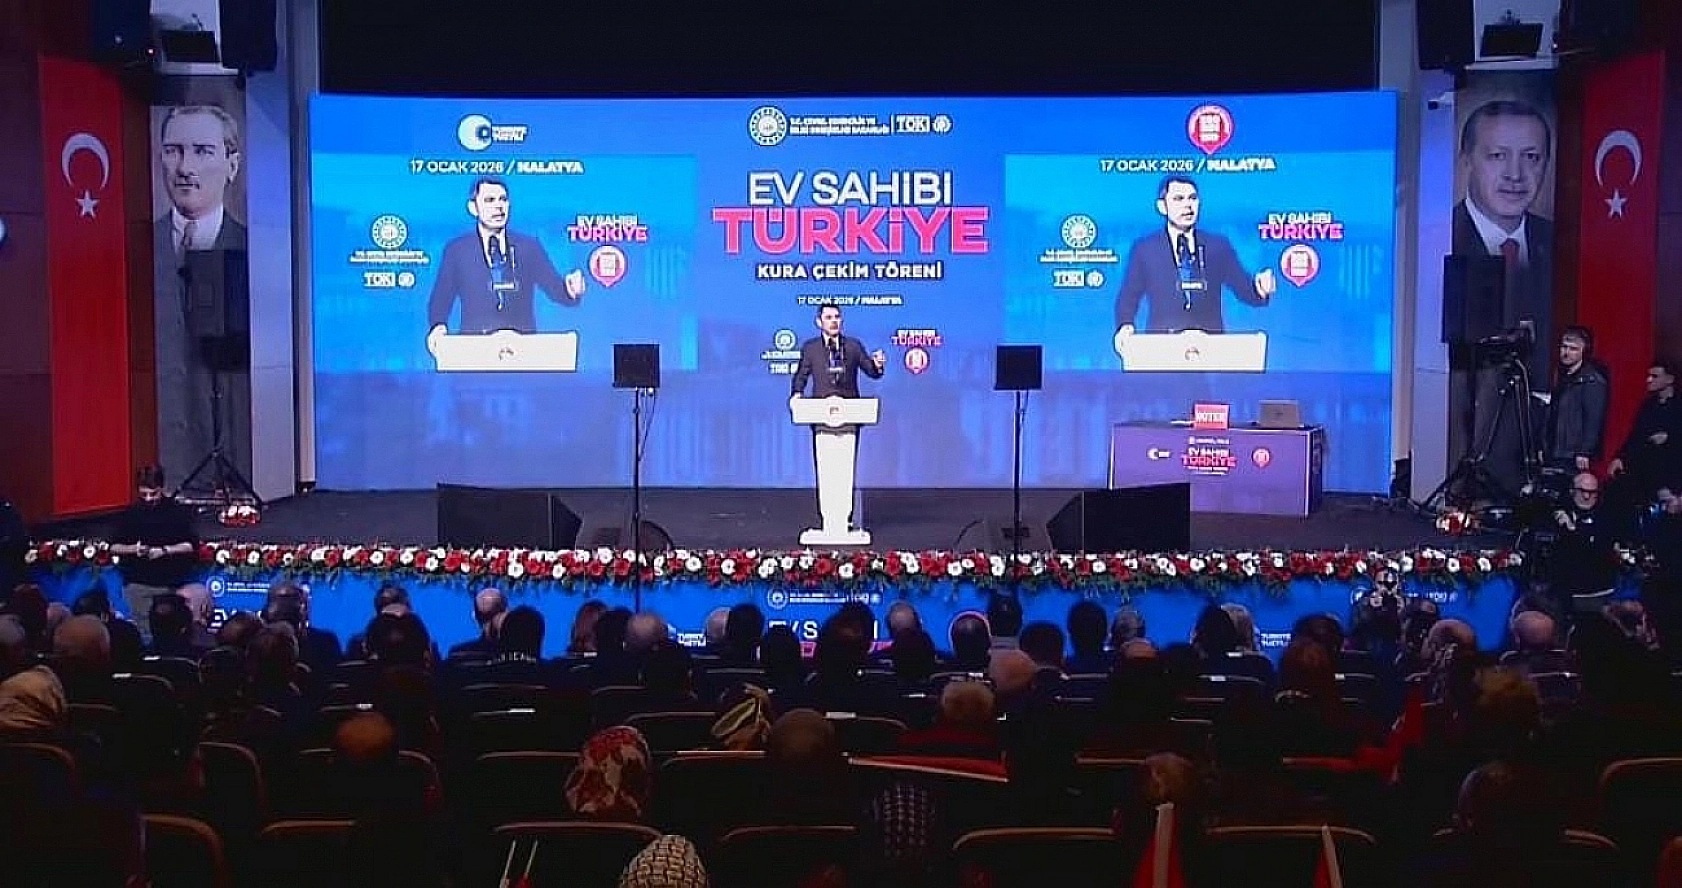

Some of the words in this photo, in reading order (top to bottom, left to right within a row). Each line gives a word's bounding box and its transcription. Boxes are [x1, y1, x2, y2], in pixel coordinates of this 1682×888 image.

[410, 160, 424, 174] 17
[427, 160, 468, 174] OCAK
[470, 160, 504, 174] 2026
[1101, 159, 1115, 172] 17
[1116, 159, 1159, 172] OCAK
[1160, 159, 1194, 172] 2026
[750, 171, 805, 205] EV
[711, 206, 990, 254] TÜRKİYE
[758, 263, 808, 279] KURA
[812, 260, 869, 281] ÇEKİM
